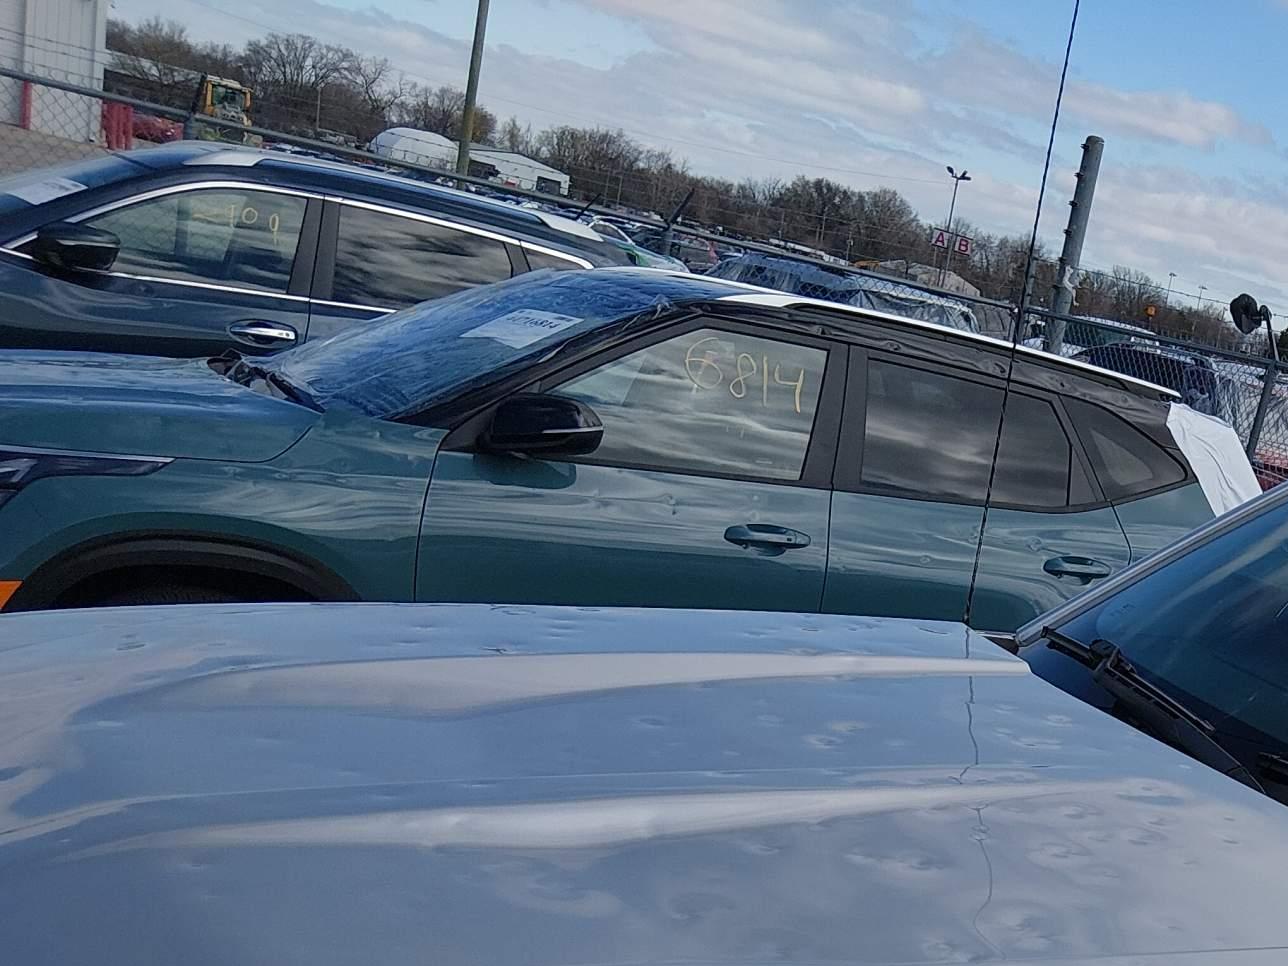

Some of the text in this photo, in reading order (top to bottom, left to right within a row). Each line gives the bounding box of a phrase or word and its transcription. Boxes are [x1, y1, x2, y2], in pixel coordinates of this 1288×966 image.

[934, 231, 945, 247] A
[958, 238, 970, 252] B
[685, 337, 804, 413] 6814
